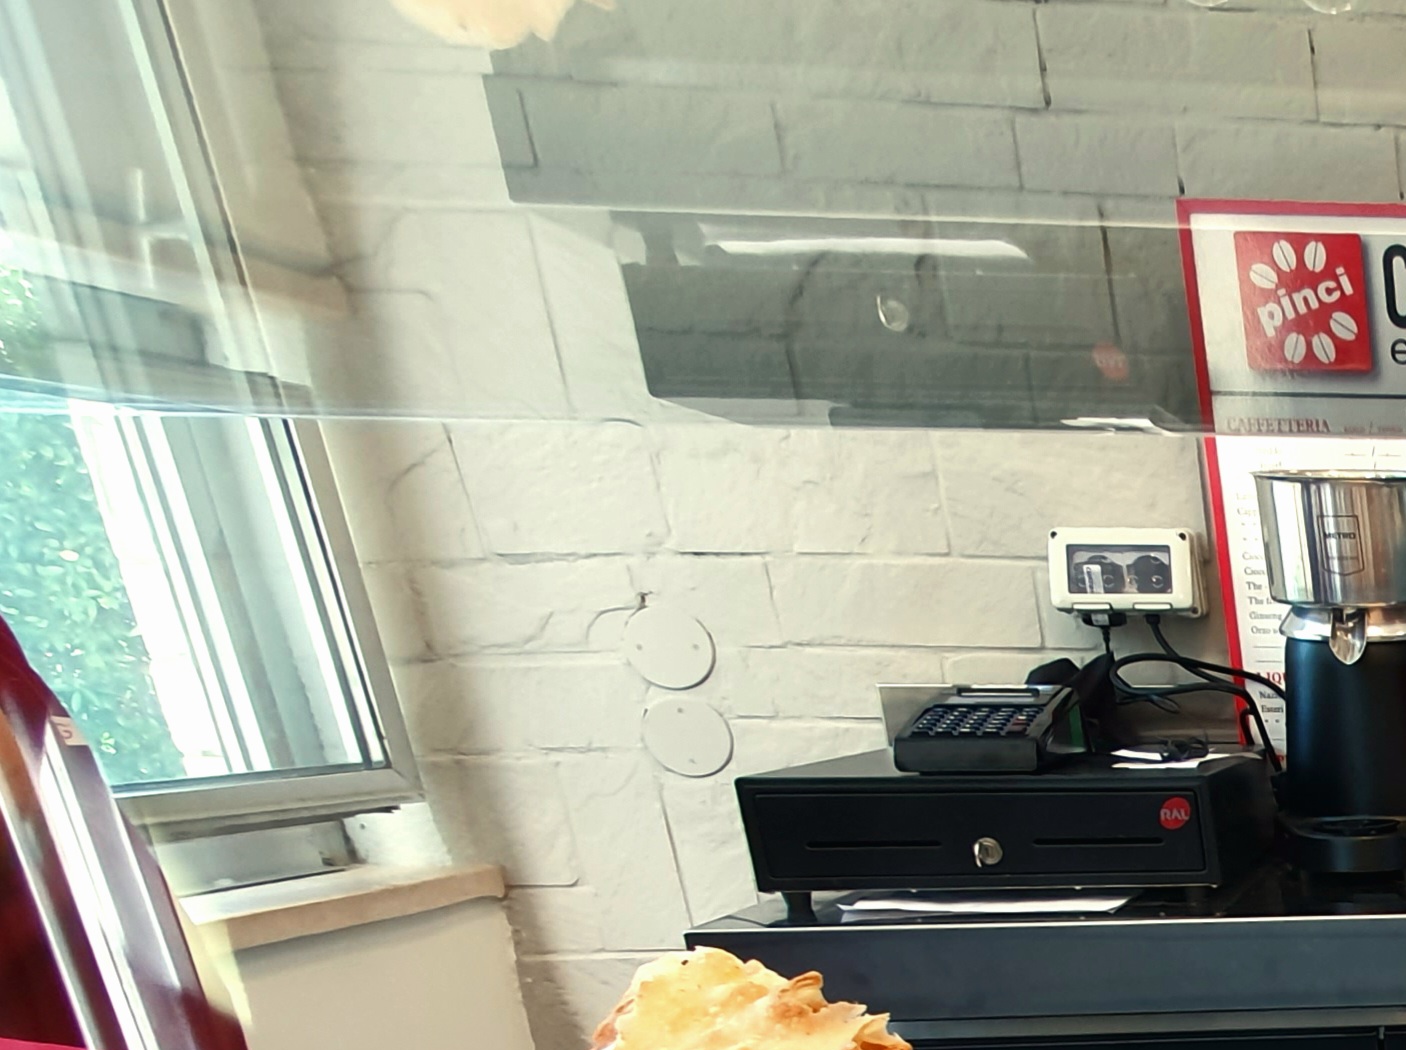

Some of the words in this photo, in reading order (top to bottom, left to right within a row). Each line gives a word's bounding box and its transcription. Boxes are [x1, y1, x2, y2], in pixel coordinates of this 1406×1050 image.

[1257, 266, 1354, 338] pinci
[1226, 417, 1331, 434] CAFFETTERIA
[1160, 808, 1190, 821] RAL
